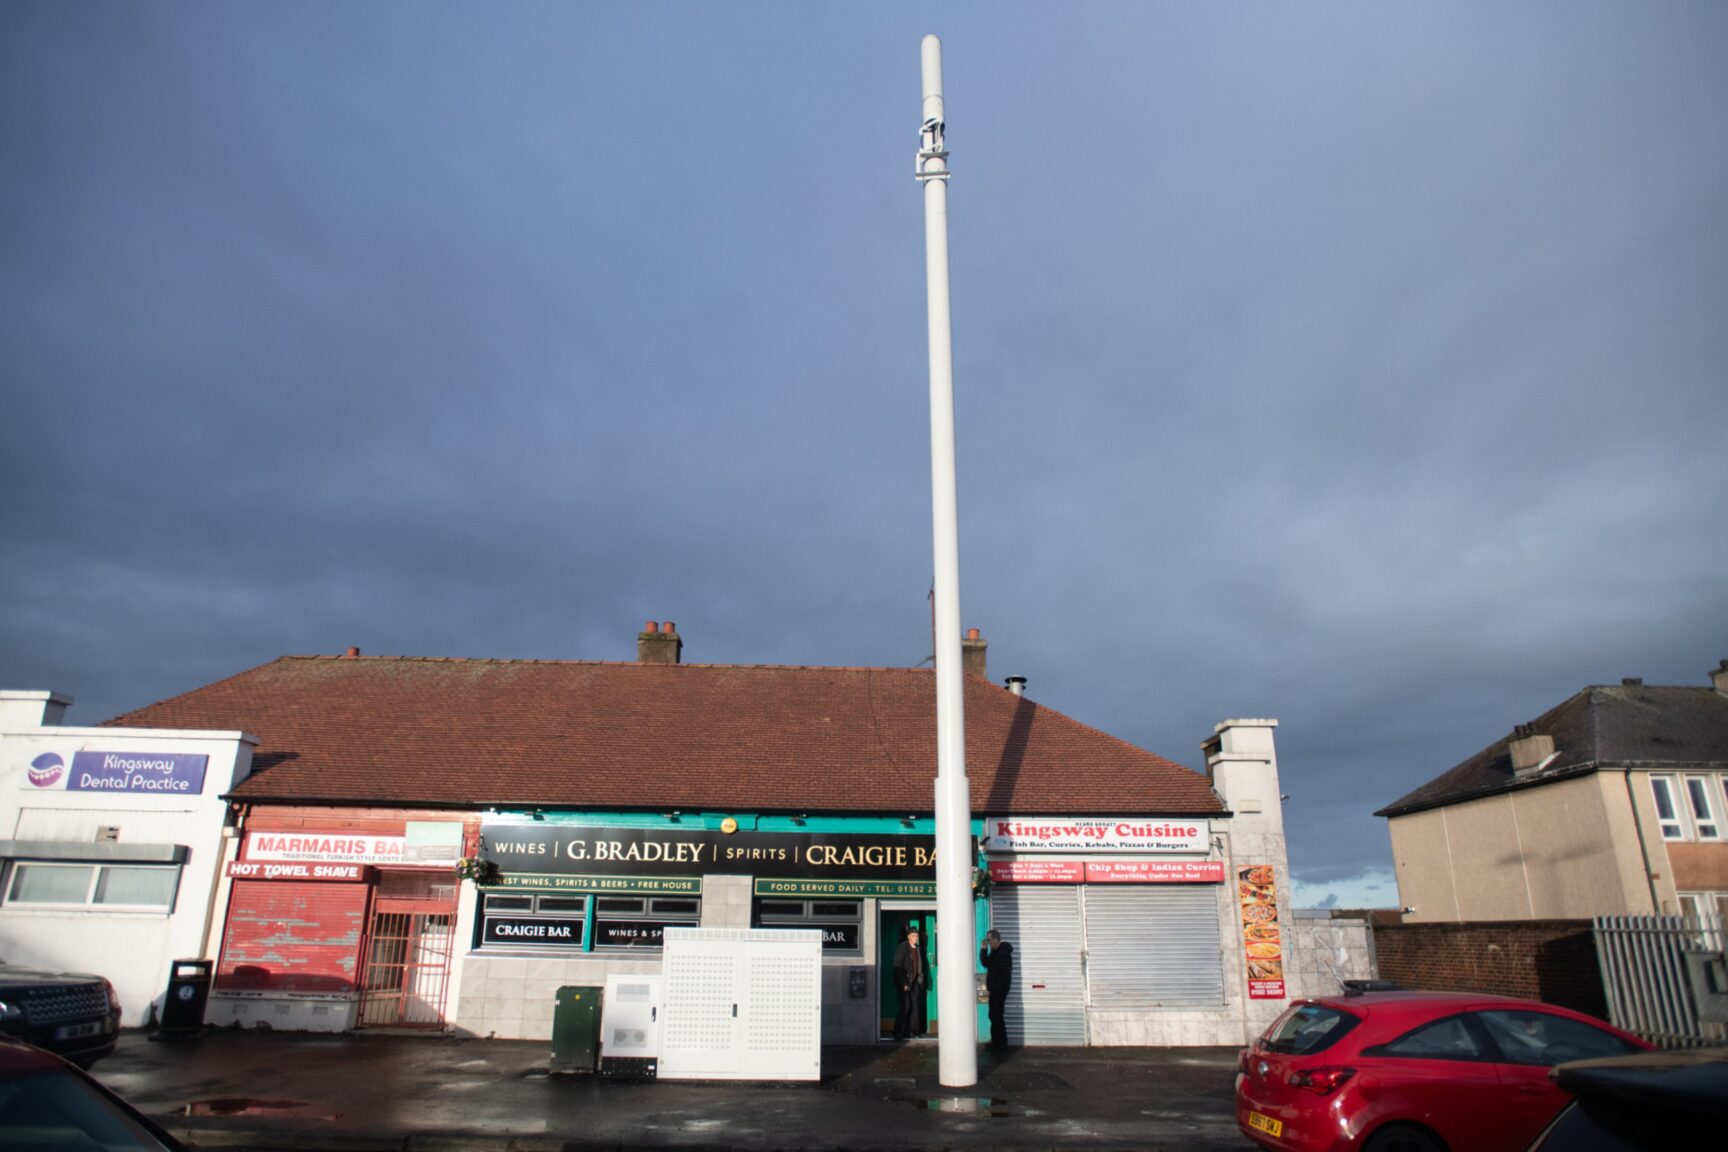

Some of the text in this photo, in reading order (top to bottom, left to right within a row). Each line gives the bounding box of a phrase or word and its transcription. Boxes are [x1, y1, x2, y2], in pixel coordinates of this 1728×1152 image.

[104, 755, 174, 773] Kingsway
[80, 773, 189, 790] Dental Practice
[997, 822, 1198, 839] Kingsway Cuisine
[257, 837, 366, 854] MARMARIS
[1029, 842, 1047, 850] Bar,
[1049, 842, 1083, 850] Curries,
[495, 842, 546, 854] WINES
[726, 847, 786, 860] SPIRITS
[806, 845, 907, 866] CRAIGIE
[914, 847, 936, 866] BA
[230, 864, 358, 877] HOT TOWEL SHAVE
[1088, 864, 1112, 872] Chip
[1114, 864, 1138, 872] Shop
[521, 878, 552, 886] WINES,
[555, 879, 588, 887] SPIRITS
[600, 880, 627, 888] BEERS
[637, 881, 659, 889] FREE
[662, 882, 692, 890] HOUSE
[771, 883, 797, 891] FOOD
[800, 884, 835, 892] SERVED
[838, 885, 865, 893] DAILY
[875, 885, 894, 893] TEL:
[495, 924, 572, 938] CRAIGIE BAR
[608, 928, 638, 938] WINES
[641, 929, 647, 937] &
[822, 930, 846, 942] BAR
